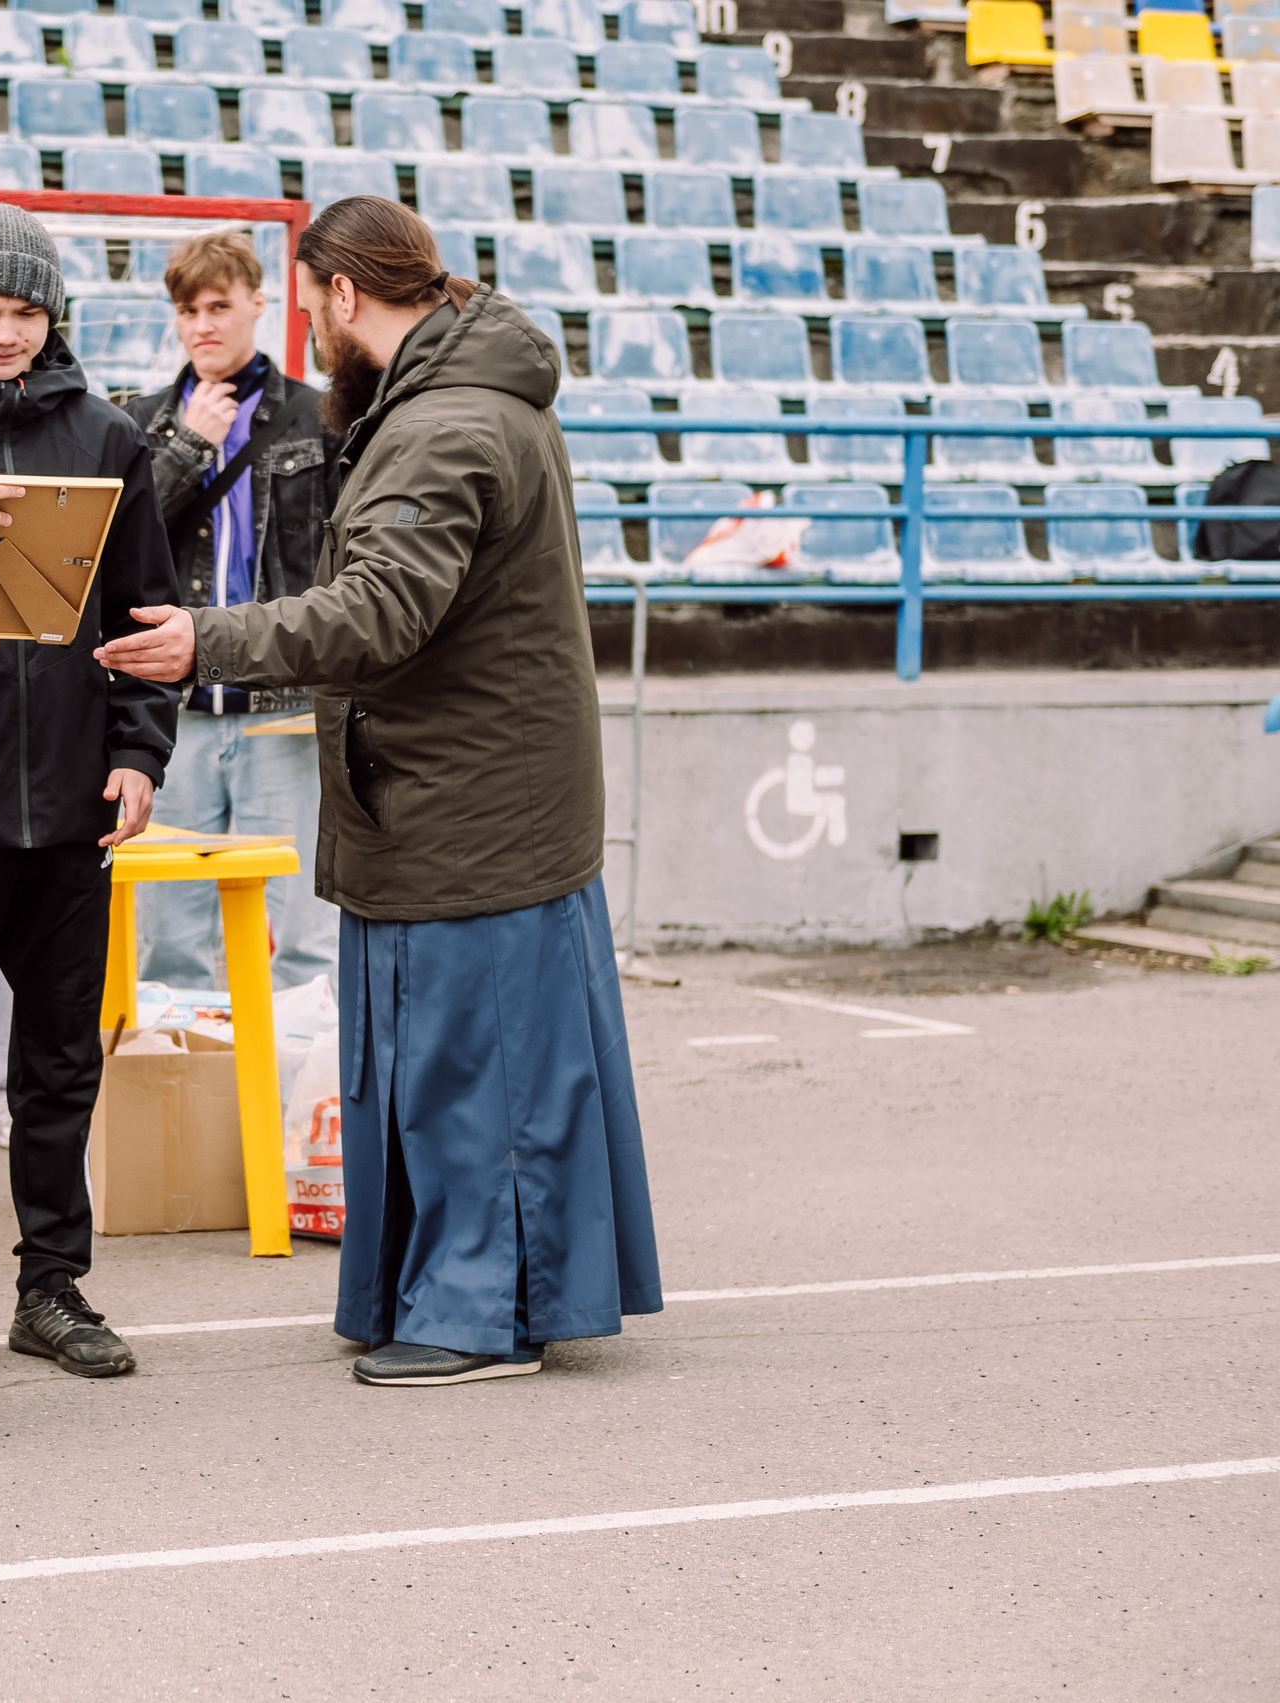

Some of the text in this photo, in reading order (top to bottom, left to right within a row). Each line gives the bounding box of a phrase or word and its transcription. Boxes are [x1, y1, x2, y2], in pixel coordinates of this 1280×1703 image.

[762, 31, 793, 78] 9
[836, 80, 867, 125] 8
[922, 132, 953, 174] 7
[1014, 199, 1048, 252] 6
[1103, 283, 1135, 325] 5
[1206, 346, 1241, 399] 4
[296, 1180, 343, 1199] Дост
[318, 1211, 339, 1230] 15
